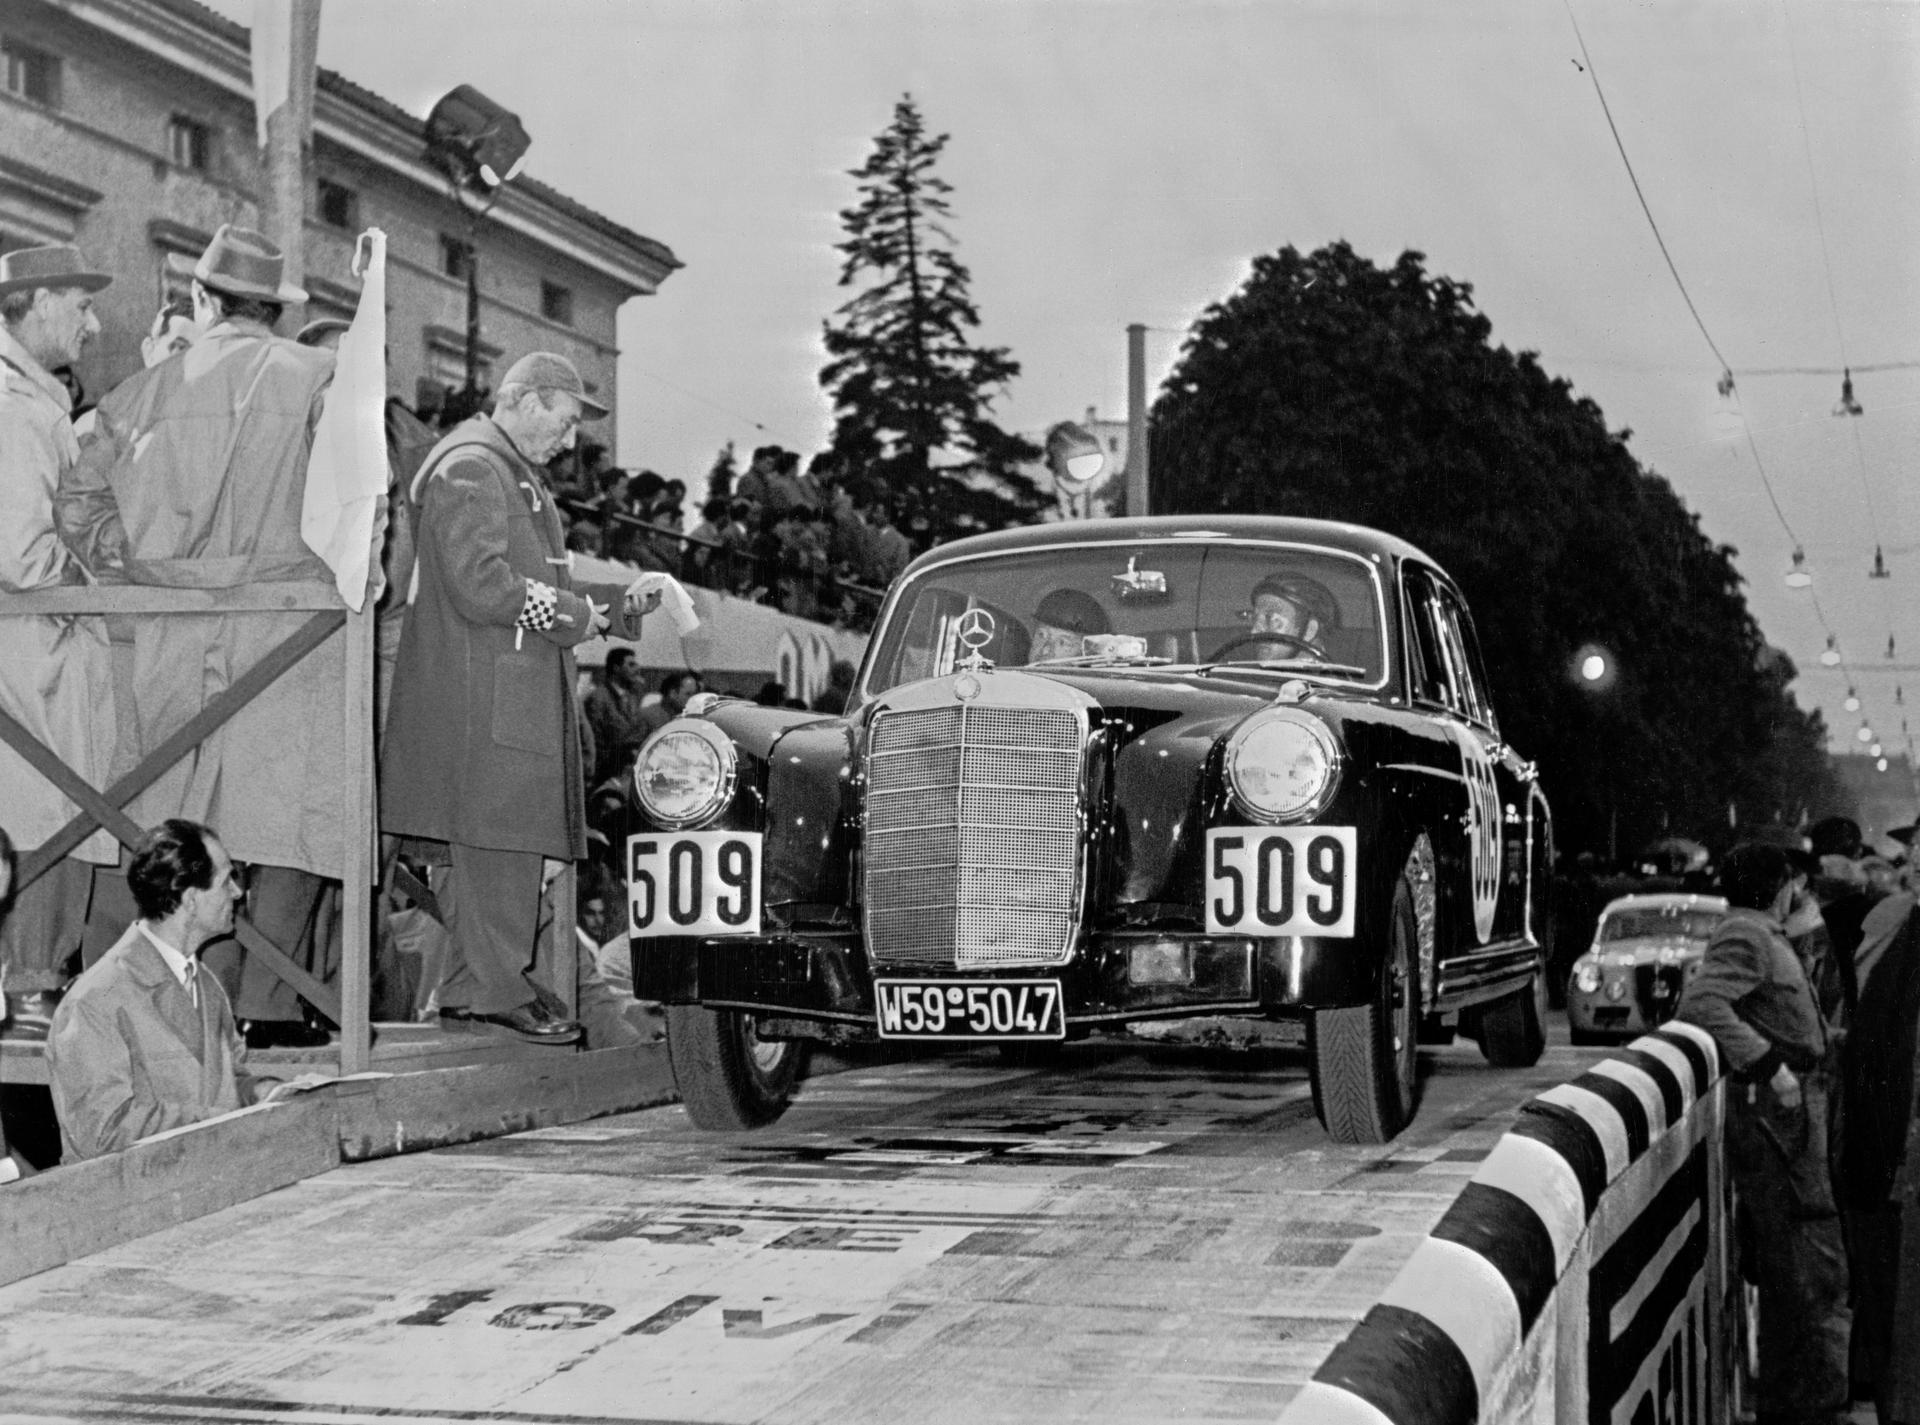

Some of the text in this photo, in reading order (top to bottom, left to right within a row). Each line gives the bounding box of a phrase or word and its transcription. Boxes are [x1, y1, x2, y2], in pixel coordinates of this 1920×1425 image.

[1463, 756, 1501, 901] 509
[632, 840, 752, 929] 509
[1213, 835, 1344, 927] 509
